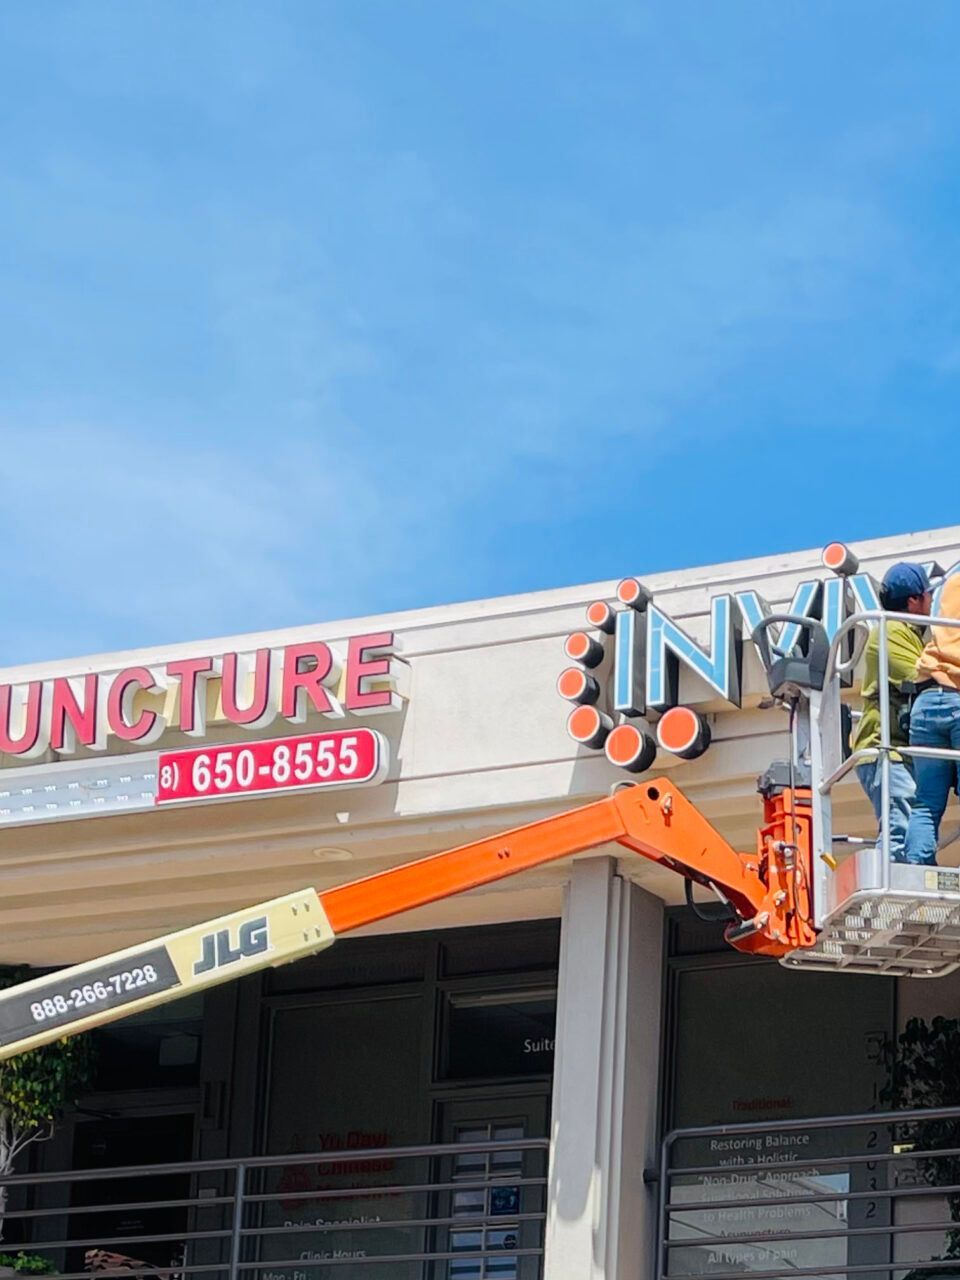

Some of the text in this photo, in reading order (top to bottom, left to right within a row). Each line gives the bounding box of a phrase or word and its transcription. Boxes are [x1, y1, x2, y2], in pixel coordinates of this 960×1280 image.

[0, 632, 394, 755] UNCTURE
[191, 737, 359, 792] 650-8555
[192, 915, 269, 976] JLG
[30, 964, 158, 1022] 888-266-7228
[710, 1134, 810, 1151] Restoring Balance
[719, 1151, 799, 1167] with a Holistic
[718, 1208, 755, 1221] Health
[758, 1206, 811, 1219] Problems
[708, 1247, 798, 1266] All types of pain
